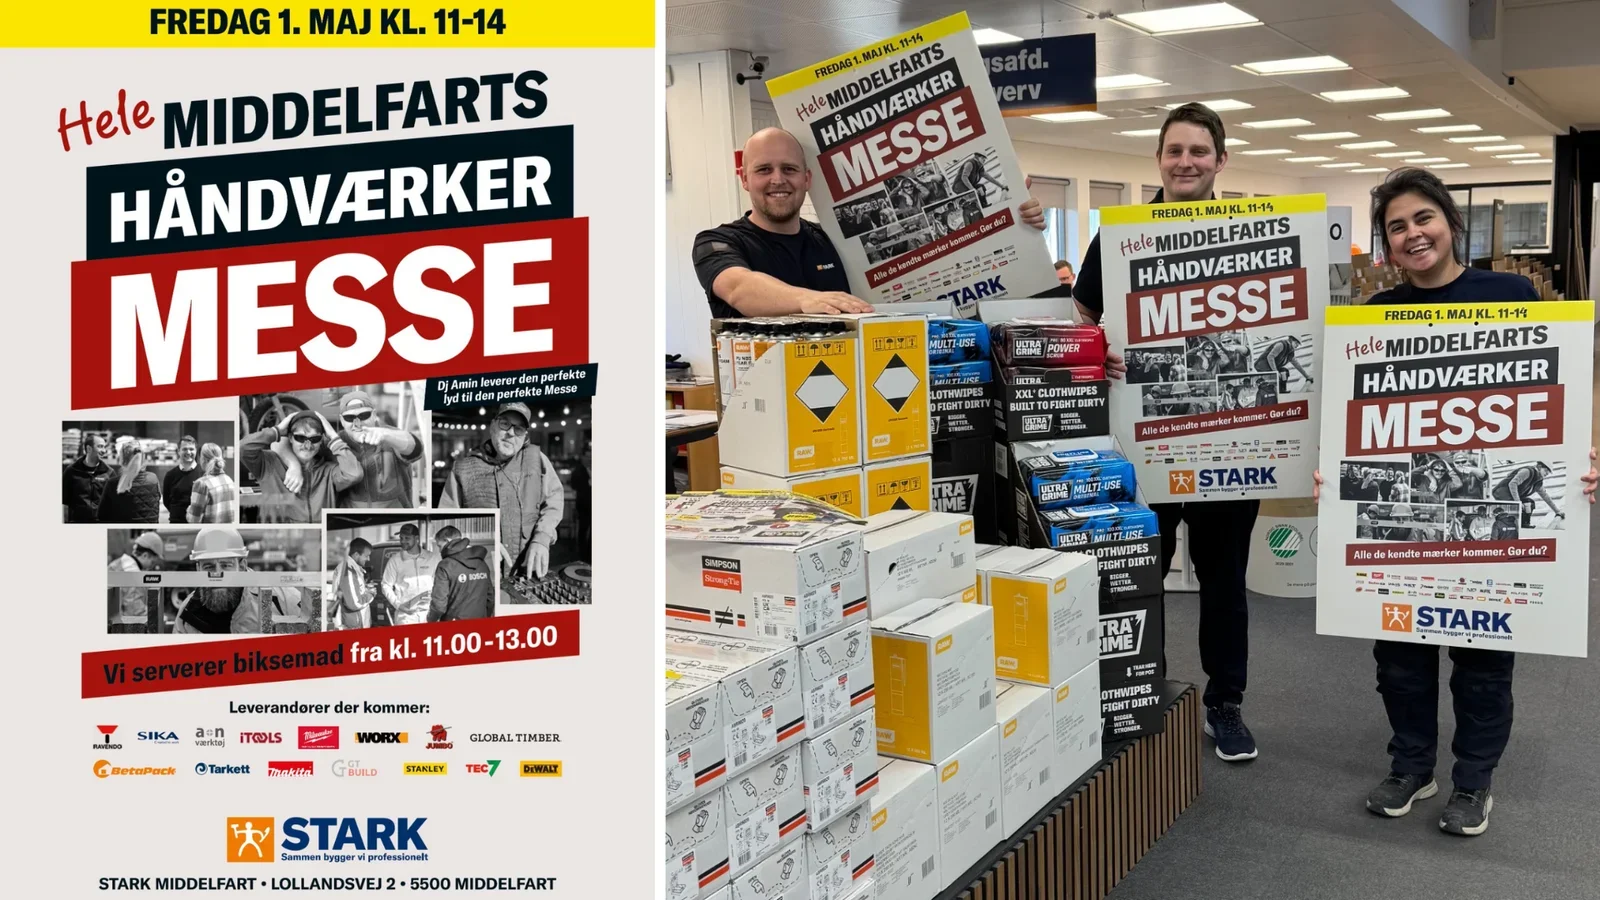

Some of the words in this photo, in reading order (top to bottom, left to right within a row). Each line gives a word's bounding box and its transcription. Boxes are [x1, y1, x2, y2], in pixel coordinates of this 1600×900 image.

[149, 8, 270, 36] FREDAG
[278, 8, 302, 36] 1.
[309, 8, 371, 36] MAJ
[380, 8, 428, 36] KL.
[433, 8, 507, 36] 11-14
[815, 58, 853, 79] FREDAG
[853, 55, 862, 64] 1.
[862, 47, 883, 63] MAJ
[884, 43, 899, 54] KL.
[899, 33, 924, 49] 11-14
[796, 94, 827, 122] Hele
[826, 42, 945, 110] MIDDELFARTS
[57, 88, 155, 153] Hele
[163, 69, 549, 151] MIDDELFARTS
[820, 70, 957, 147] HÅNDVÆRKER
[830, 96, 974, 194] MESSE
[110, 155, 553, 244] HÅNDVÆRKER
[1152, 207, 1193, 219] FREDAG
[1195, 206, 1203, 217] 1.
[1205, 205, 1227, 216] MAJ
[1229, 204, 1245, 215] KL.
[1120, 233, 1155, 257] Hele
[1155, 216, 1291, 253] MIDDELFARTS
[873, 270, 888, 282] Alle
[888, 264, 898, 275] de
[897, 253, 922, 271] kendte
[923, 243, 949, 260] mærker
[949, 231, 980, 248] kommer.
[980, 222, 993, 234] Gør
[993, 215, 1007, 226] du?
[1138, 246, 1293, 287] HÅNDVÆRKER
[1139, 275, 1296, 337] MESSE
[110, 237, 554, 391] MESSE
[1384, 309, 1433, 321] FREDAG
[1435, 309, 1444, 320] 1.
[1447, 308, 1473, 320] MAJ
[1476, 308, 1495, 319] KL.
[930, 338, 976, 349] MULTI-USE
[1016, 339, 1043, 348] ULTRA
[1047, 343, 1080, 353] POWER
[1345, 335, 1384, 360] Hele
[1385, 325, 1549, 358] MIDDELFARTS
[1016, 348, 1042, 356] GRIME
[437, 380, 449, 392] Dj
[450, 378, 478, 390] Amin
[480, 375, 516, 388] leverer
[518, 373, 539, 385] den
[540, 369, 586, 385] perfekte
[1016, 376, 1042, 384] ULTRA
[1362, 359, 1549, 394] HÅNDVÆRKER
[443, 393, 459, 406] lyd
[461, 391, 473, 402] til
[475, 390, 494, 402] den
[497, 386, 542, 402] perfekte
[544, 384, 578, 396] Messe
[1038, 386, 1098, 398] CLOTHWIPES
[937, 401, 964, 411] FIGHT
[964, 399, 991, 409] DIRTY
[1009, 401, 1036, 412] BUILT
[1037, 401, 1048, 410] TO
[1050, 399, 1077, 410] FIGHT
[1078, 397, 1106, 408] DIRTY
[1025, 417, 1048, 426] ULTRA
[1141, 427, 1158, 436] Alle
[1159, 424, 1170, 434] de
[1171, 421, 1199, 432] kendte
[1200, 417, 1231, 428] mærker
[1233, 413, 1268, 424] kommer.
[1269, 410, 1284, 419] Gør
[1286, 407, 1302, 417] du?
[1360, 391, 1549, 450] MESSE
[1025, 424, 1048, 434] GRIME
[1198, 466, 1277, 487] STARK
[1041, 483, 1068, 493] ULTRA
[1074, 479, 1121, 495] MULTI-USE
[1041, 491, 1068, 501] GRIME
[932, 495, 967, 513] RIME
[1060, 533, 1088, 544] ULTRA
[1094, 530, 1144, 543] MULTI-USE
[1353, 550, 1372, 559] Alle
[1373, 549, 1386, 559] de
[1387, 549, 1421, 559] kendte
[1422, 548, 1460, 558] mærker
[1462, 547, 1505, 557] kommer.
[1507, 546, 1526, 556] Gør
[1528, 545, 1548, 556] du?
[704, 558, 738, 570] SIMPSON
[1098, 559, 1127, 571] FIGHT
[1127, 555, 1157, 568] DIRTY
[1416, 605, 1513, 633] STARK
[103, 662, 125, 685] Vi
[132, 657, 227, 683] serverer
[233, 644, 344, 674] biksemad
[350, 640, 384, 664] fra
[389, 637, 417, 660] kl.
[1100, 684, 1152, 701] OTHWIPES
[229, 700, 330, 714] Leverandører
[334, 700, 360, 714] der
[363, 700, 430, 714] kommer:
[1102, 700, 1130, 713] FIGHT
[1131, 695, 1160, 709] DIRTY
[137, 731, 179, 741] SIKA
[195, 738, 226, 748] værktøj
[357, 732, 401, 744] WORX
[469, 733, 513, 743] GLOBAL
[515, 733, 561, 743] TIMBER
[425, 742, 454, 750] JUMBO
[110, 766, 176, 776] BetaPack
[208, 764, 251, 775] Tarkett
[348, 768, 378, 777] BUILD
[406, 765, 444, 773] STANLEY
[465, 759, 502, 778] TEC7
[280, 817, 429, 852] STARK
[280, 852, 321, 862] Sammen
[323, 852, 356, 863] bygger
[357, 852, 366, 862] vi
[367, 852, 429, 863] professionelt
[98, 877, 151, 891] STARK
[155, 877, 257, 891] MIDDELFART
[271, 877, 382, 891] LOLLANDSVEJ
[386, 877, 396, 891] 2
[409, 877, 451, 891] 5500
[455, 877, 557, 891] MIDDELFART
